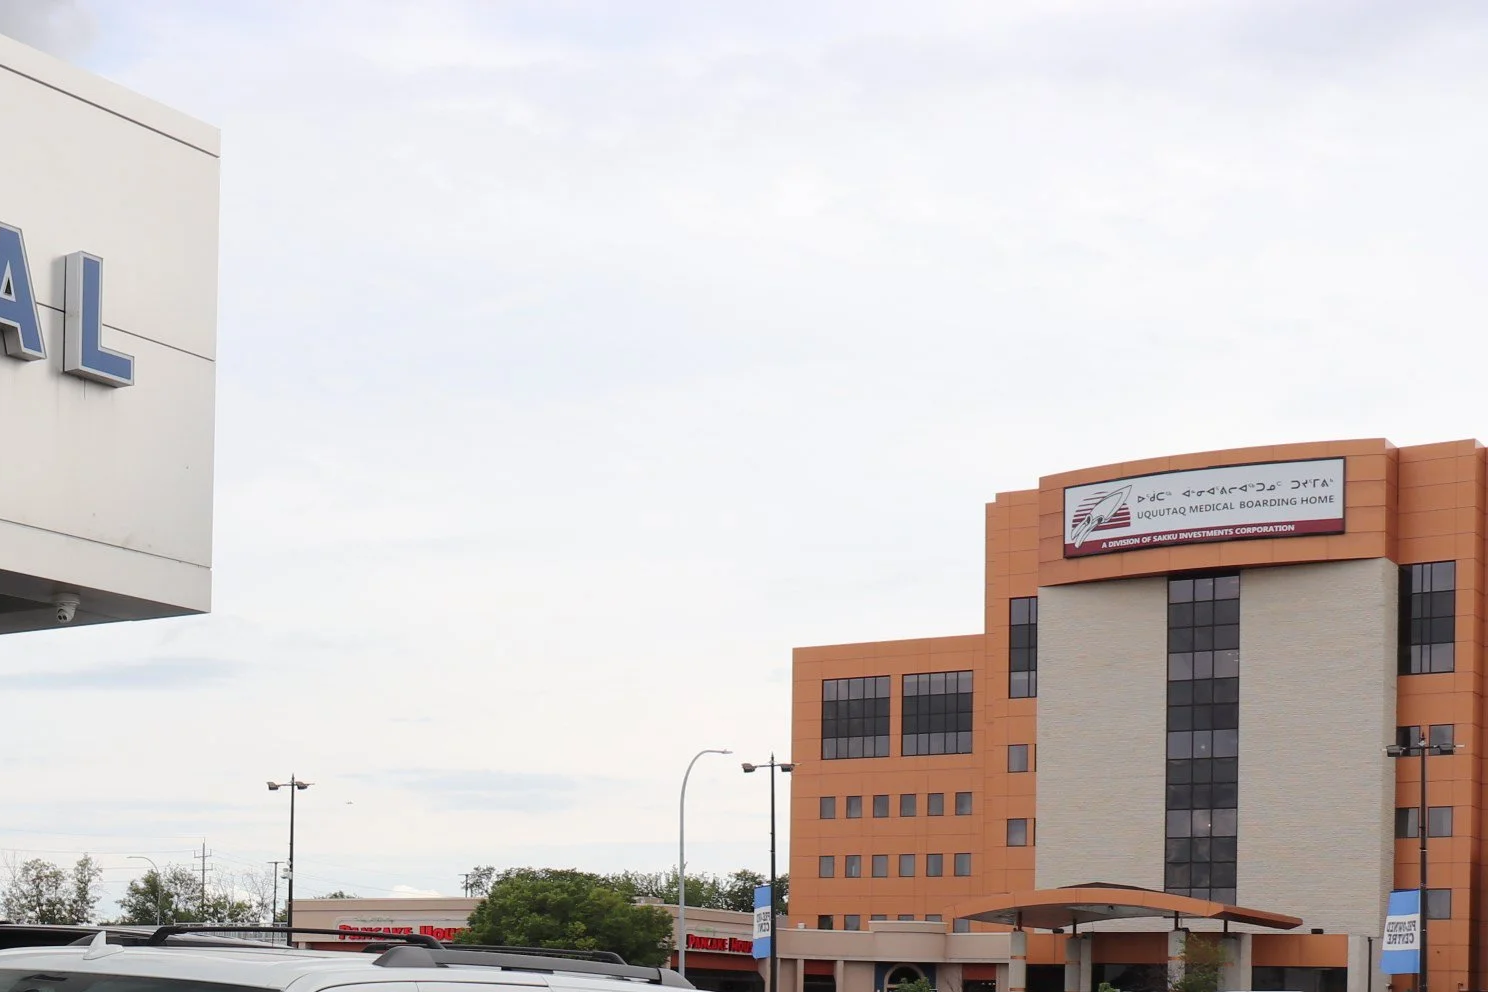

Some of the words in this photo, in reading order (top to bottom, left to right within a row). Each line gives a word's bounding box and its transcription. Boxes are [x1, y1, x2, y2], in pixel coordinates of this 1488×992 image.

[1137, 506, 1186, 519] UQUUTAQ
[1189, 502, 1235, 513] MEDICAL
[1239, 497, 1297, 509] BOARDING
[1300, 495, 1335, 505] HOME
[1108, 538, 1140, 548] DIVISION
[1152, 533, 1178, 542] SAKKU
[1179, 528, 1234, 539] INVESTMENTS
[1235, 524, 1296, 535] CORPORATION
